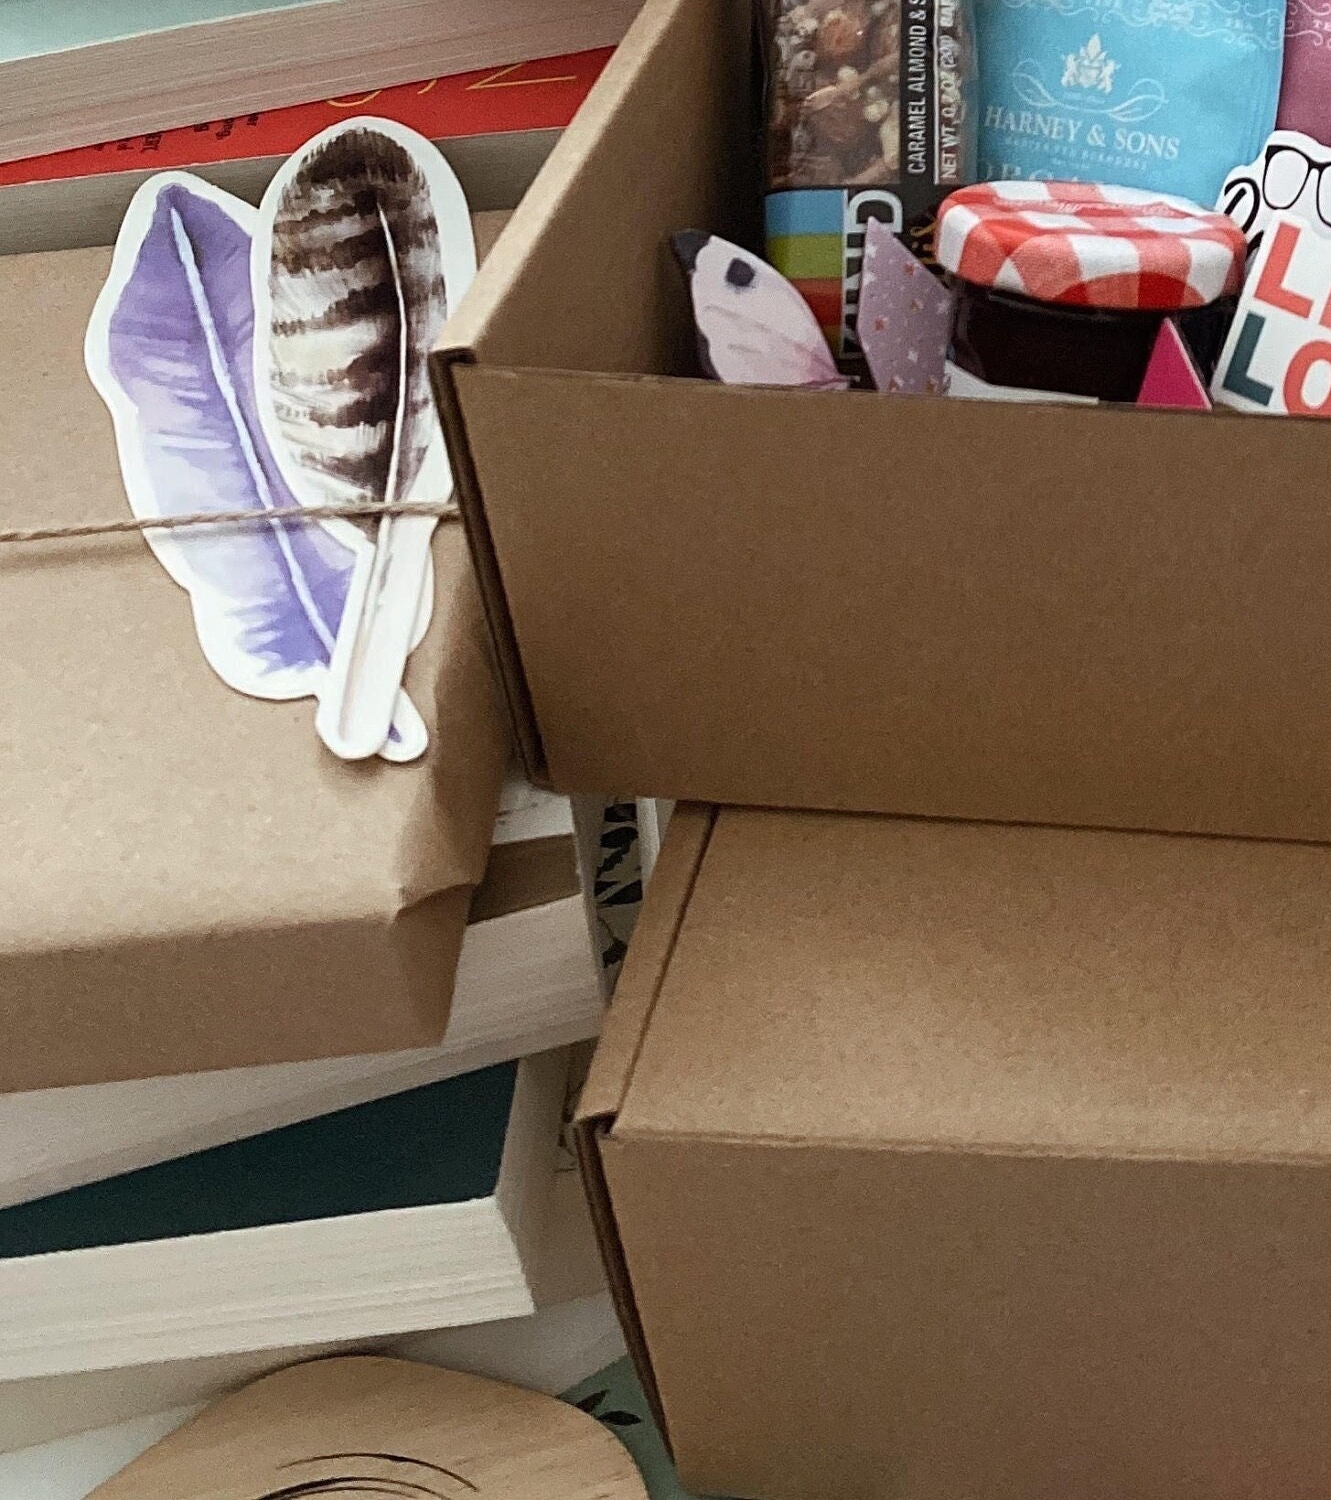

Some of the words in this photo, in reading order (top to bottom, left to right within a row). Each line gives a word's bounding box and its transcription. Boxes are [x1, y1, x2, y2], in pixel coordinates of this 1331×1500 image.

[914, 8, 926, 22] &
[911, 24, 927, 93] ALMOND
[908, 97, 927, 174] CARAMEL
[985, 107, 1082, 142] HARNEY
[1087, 124, 1106, 147] &
[1115, 128, 1180, 160] SONS
[940, 150, 956, 179] NET
